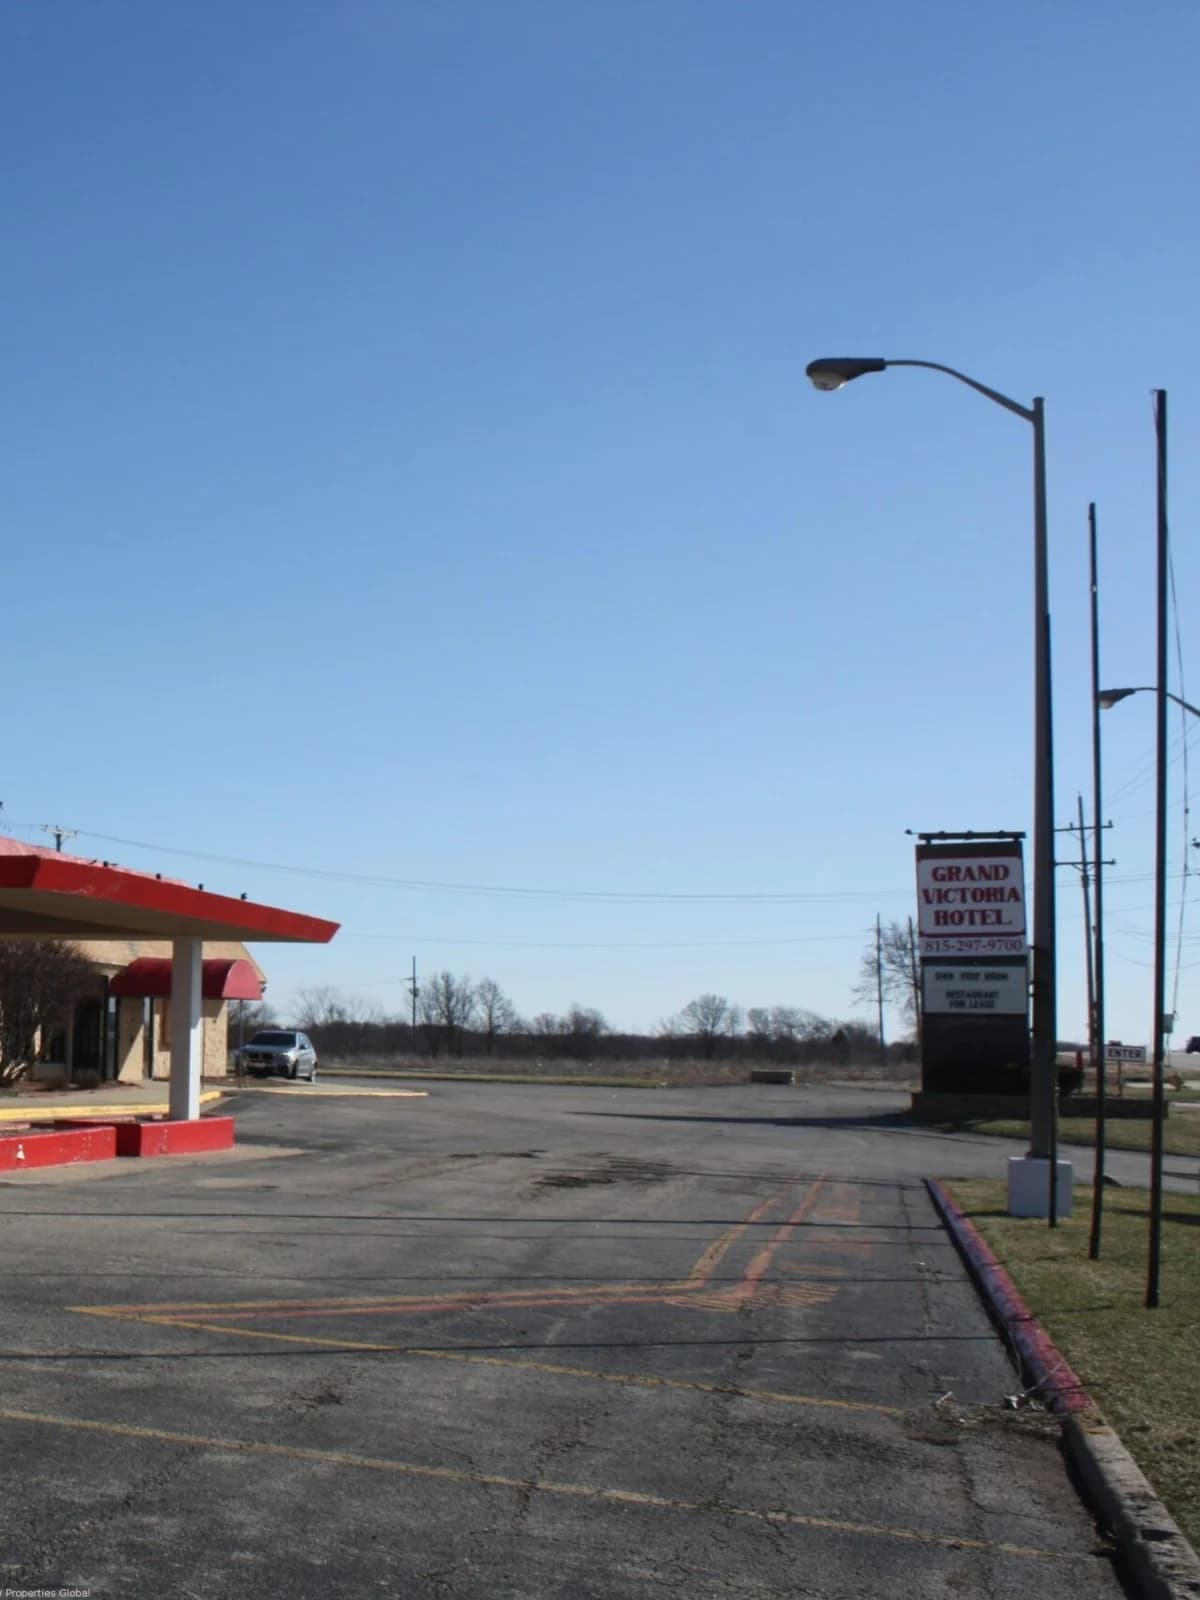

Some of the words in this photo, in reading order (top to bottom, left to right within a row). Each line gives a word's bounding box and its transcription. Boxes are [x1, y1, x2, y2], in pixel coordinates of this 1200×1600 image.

[931, 864, 1010, 882] GRAND
[922, 886, 1021, 905] VICTORIA
[949, 1000, 966, 1009] FOR
[969, 1000, 995, 1009] LEASE
[1108, 1047, 1142, 1058] ENTER
